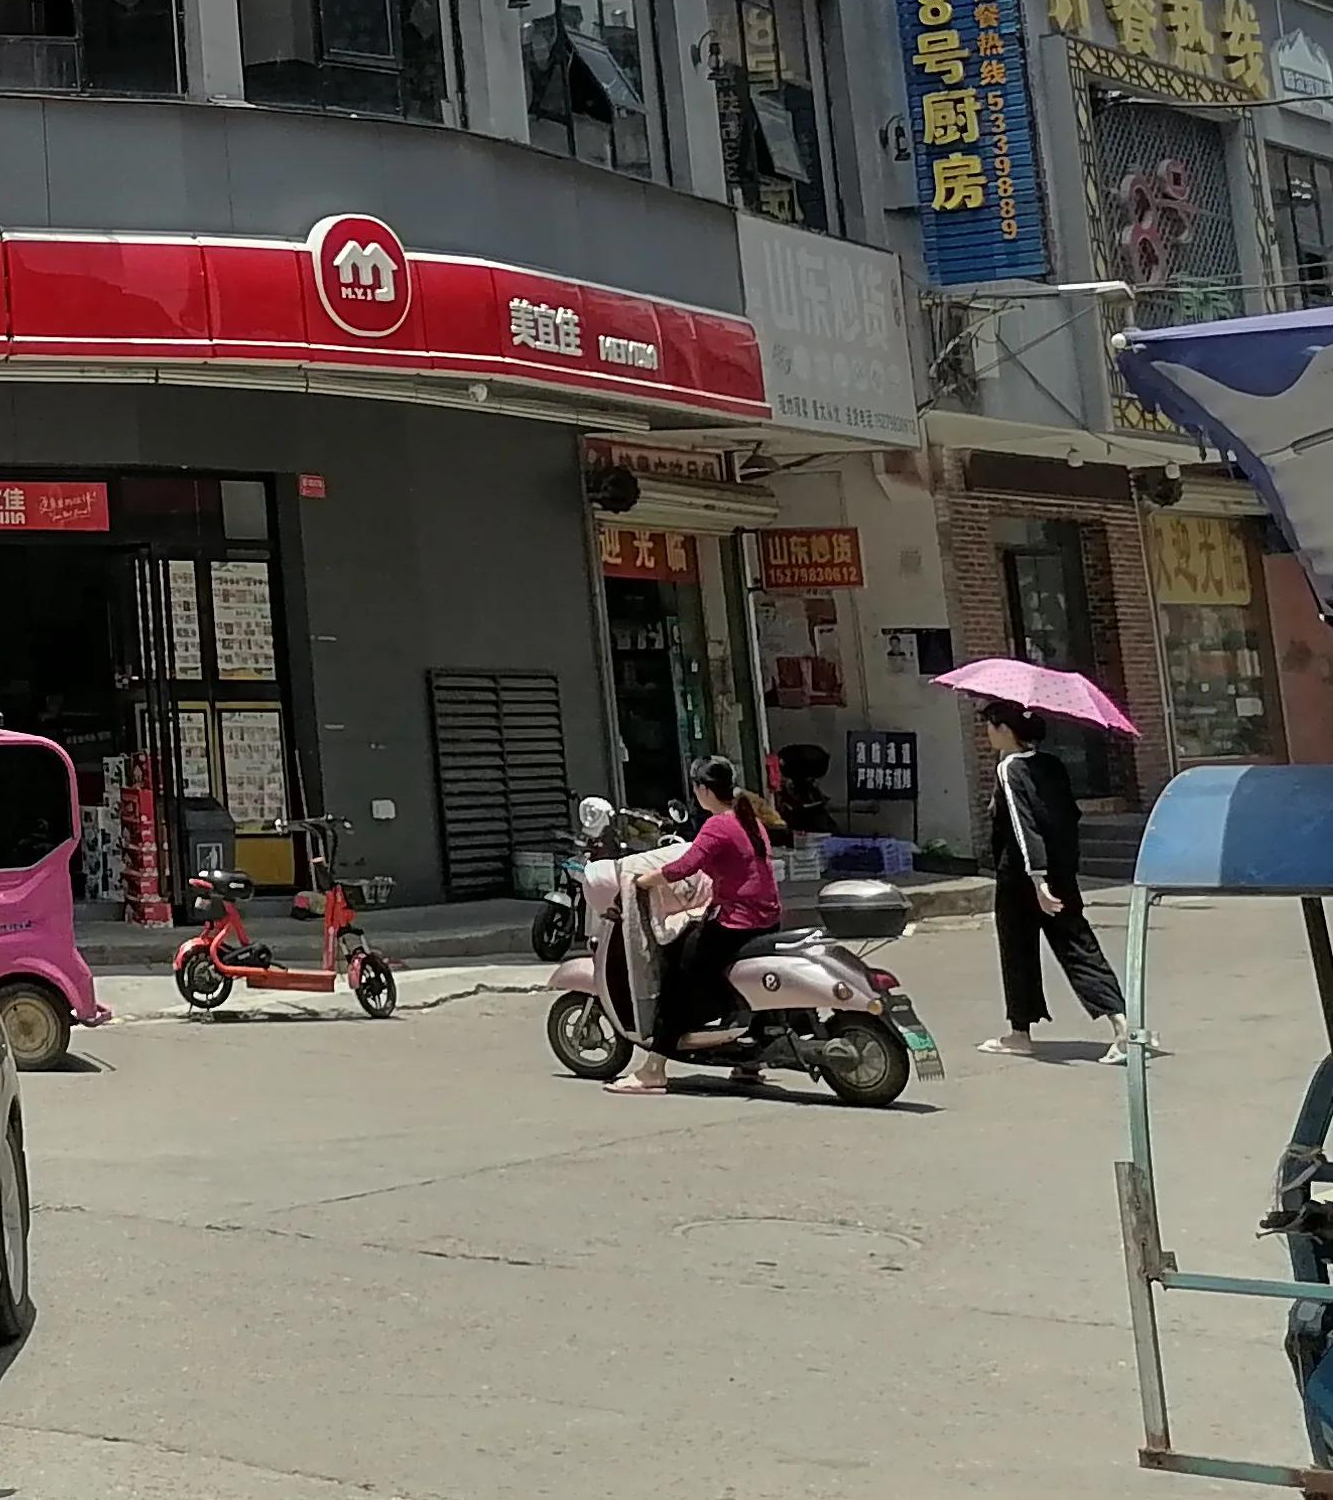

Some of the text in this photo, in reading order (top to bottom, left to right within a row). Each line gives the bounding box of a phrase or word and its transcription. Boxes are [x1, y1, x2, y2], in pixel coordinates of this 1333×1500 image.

[509, 298, 583, 357] 美宜佳
[767, 534, 853, 566] 山东炒货
